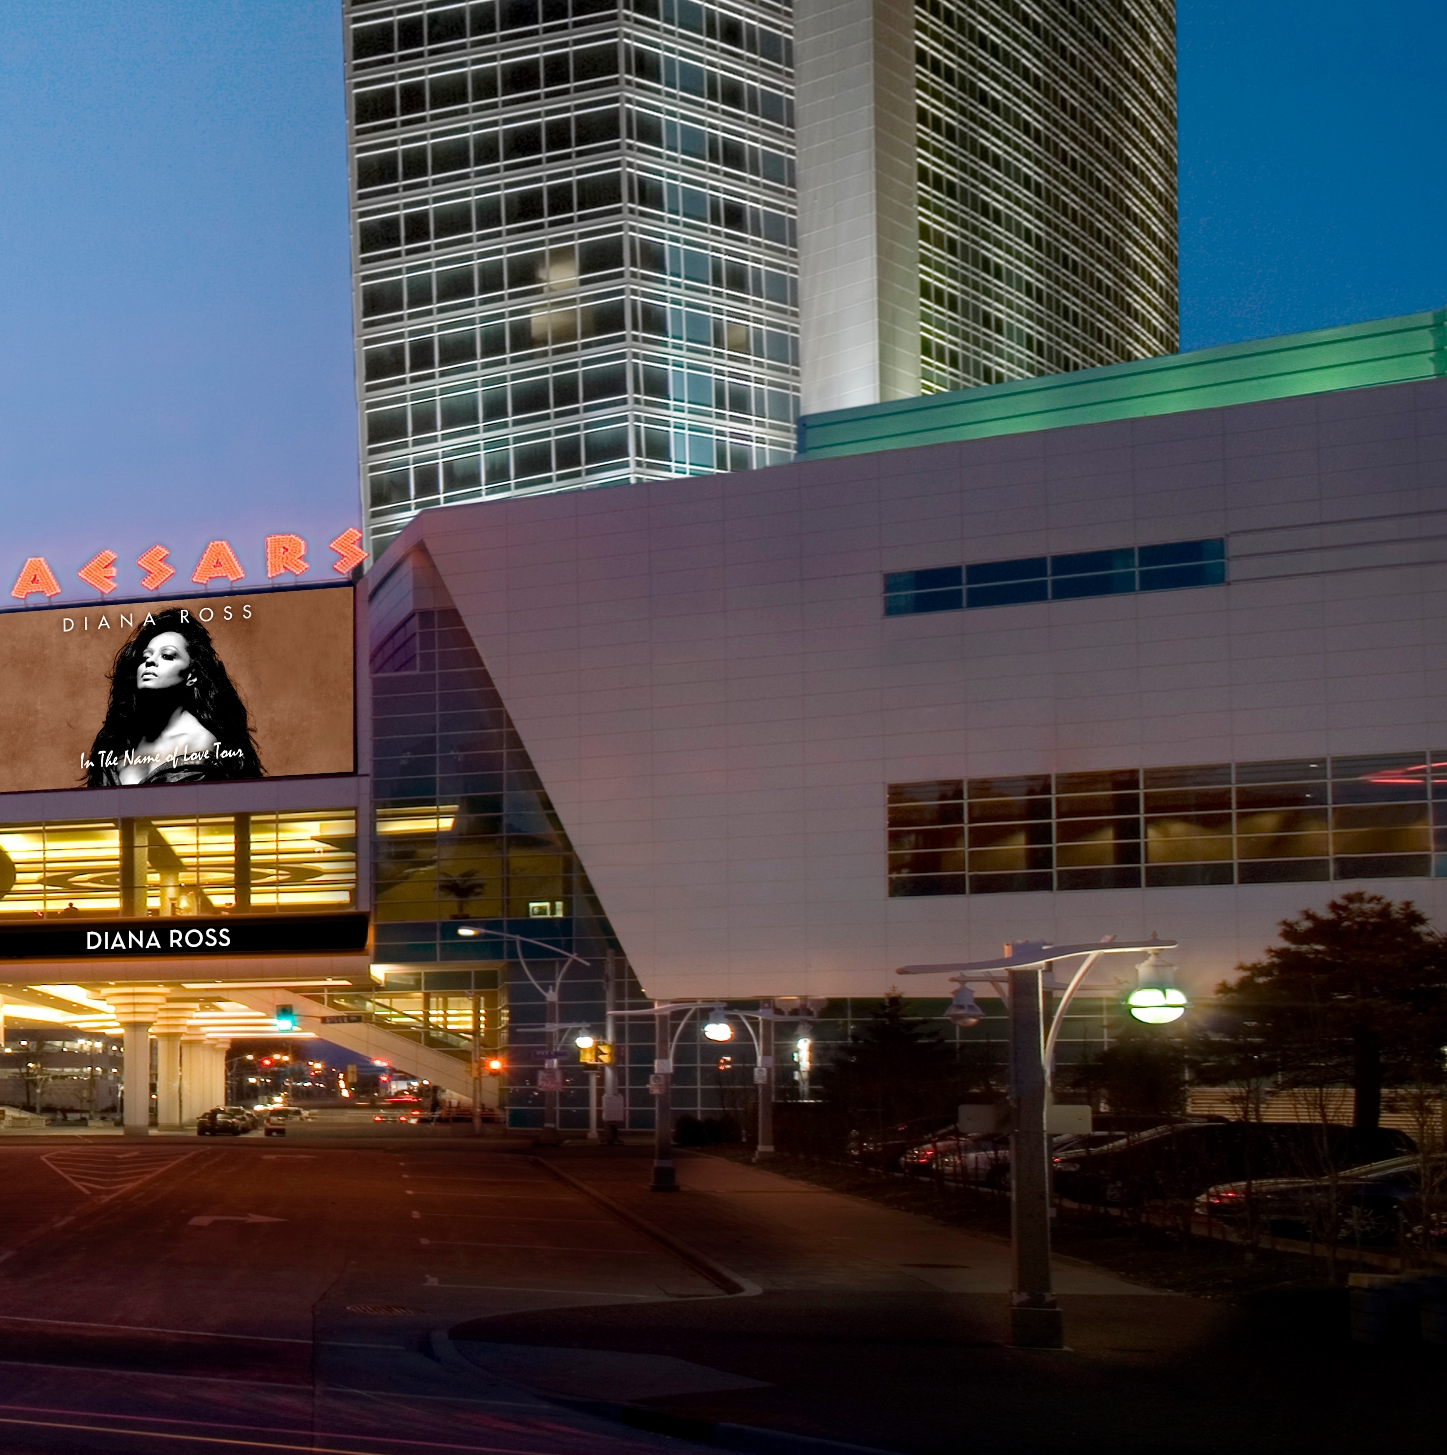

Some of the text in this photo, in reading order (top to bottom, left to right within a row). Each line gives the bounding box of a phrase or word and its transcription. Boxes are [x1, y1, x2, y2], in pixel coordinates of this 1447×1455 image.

[63, 604, 252, 632] DIANA ROSS
[80, 742, 244, 769] In The Name of Love Tour
[87, 928, 231, 950] DIANA ROSS
